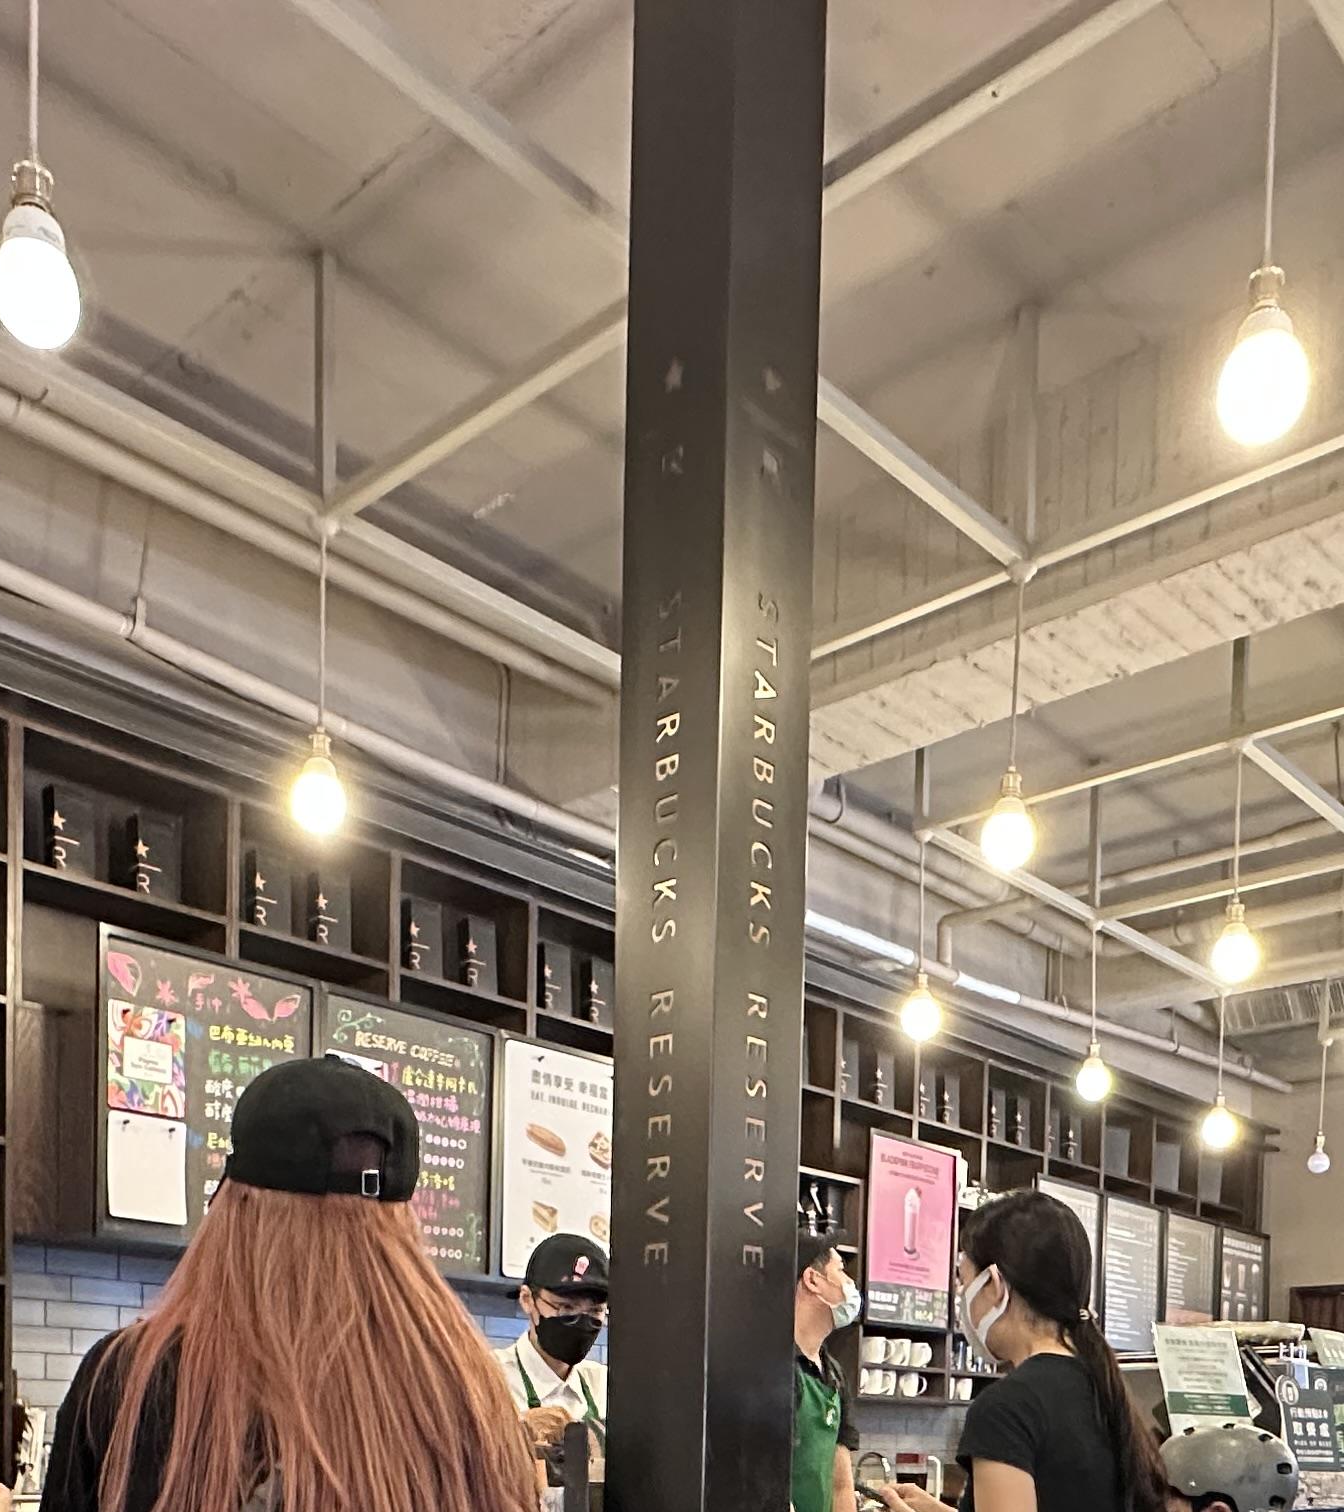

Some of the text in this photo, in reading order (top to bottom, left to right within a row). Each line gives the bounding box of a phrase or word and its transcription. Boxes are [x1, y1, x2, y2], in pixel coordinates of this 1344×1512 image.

[54, 846, 66, 868] R
[137, 873, 150, 894] R
[255, 905, 267, 926] R
[317, 924, 329, 944] R
[644, 591, 681, 1265] STARBUCKS RESERVE
[743, 591, 779, 1269] STARBUCKS RESERVE
[411, 951, 421, 970] R
[467, 967, 478, 988] R
[354, 1030, 457, 1068] RESERVE COFFEE
